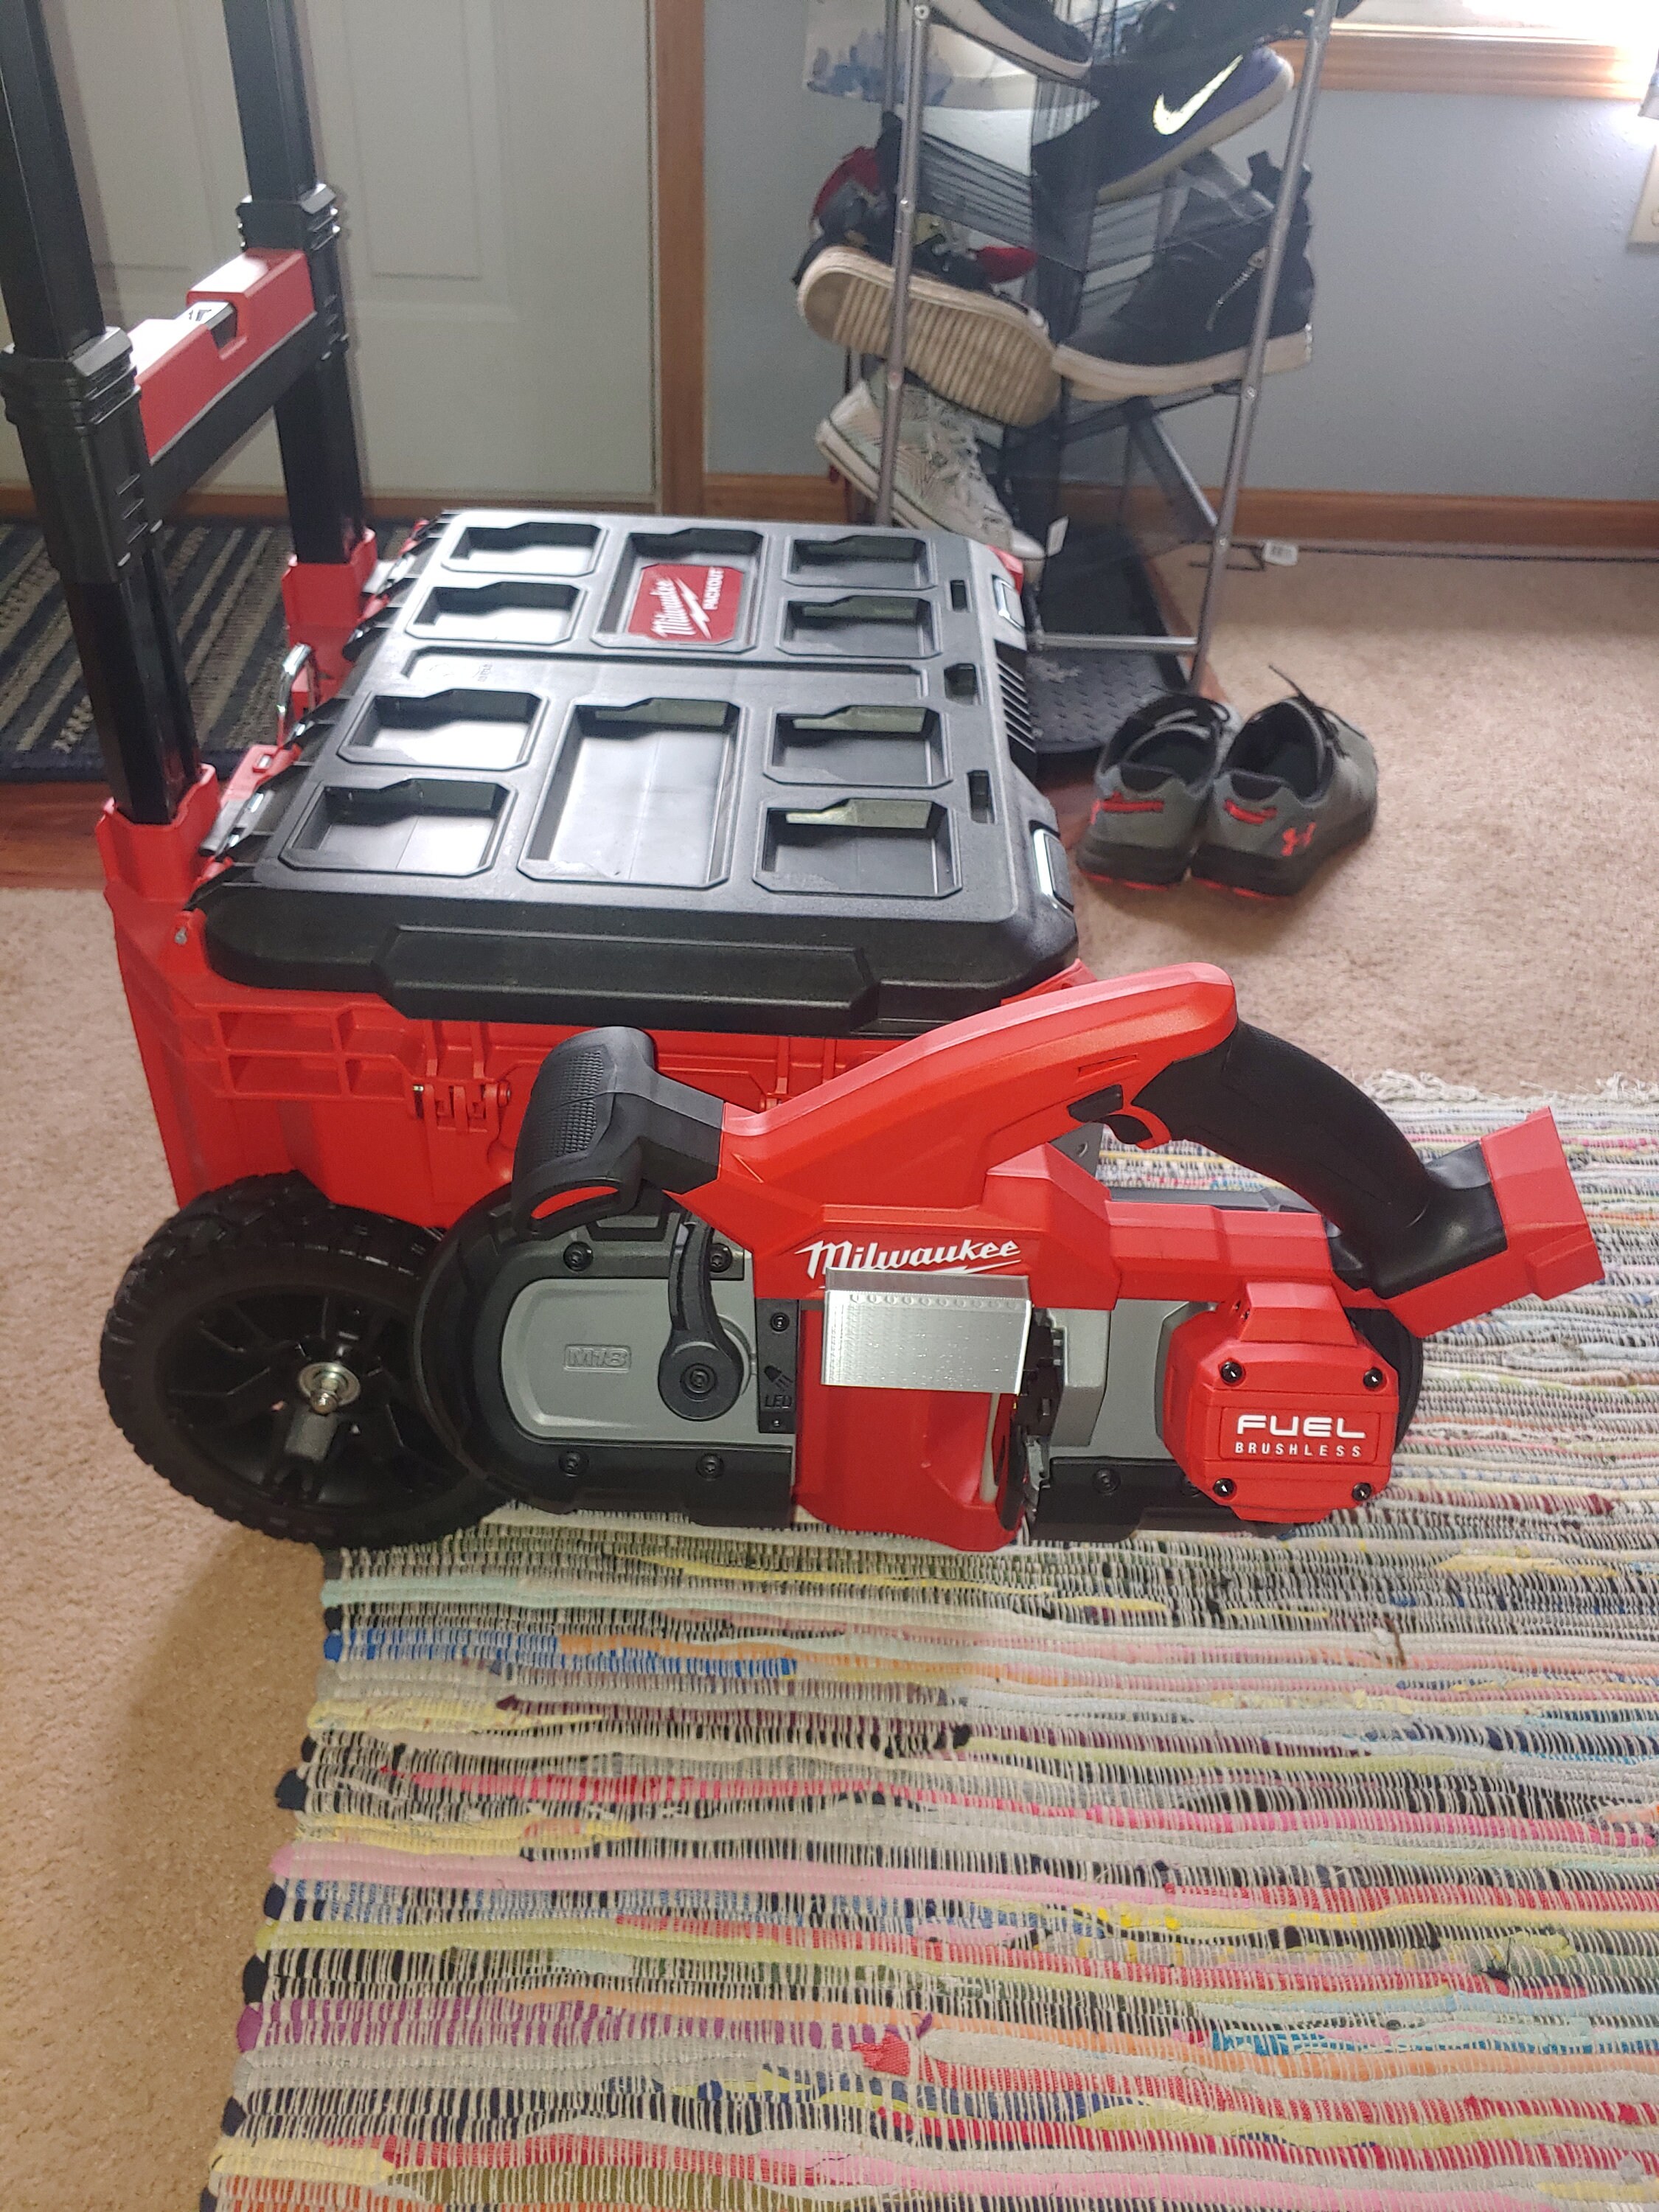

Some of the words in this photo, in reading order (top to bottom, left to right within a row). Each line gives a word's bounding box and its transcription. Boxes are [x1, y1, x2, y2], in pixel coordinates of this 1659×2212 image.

[702, 566, 725, 611] PACKOUT
[650, 577, 697, 638] Milwaukee
[794, 1239, 1021, 1279] Milwaukee
[567, 1347, 628, 1367] M18
[765, 1394, 793, 1408] LED
[1237, 1414, 1367, 1439] FUEL
[1234, 1441, 1362, 1458] BRUSHLESS
